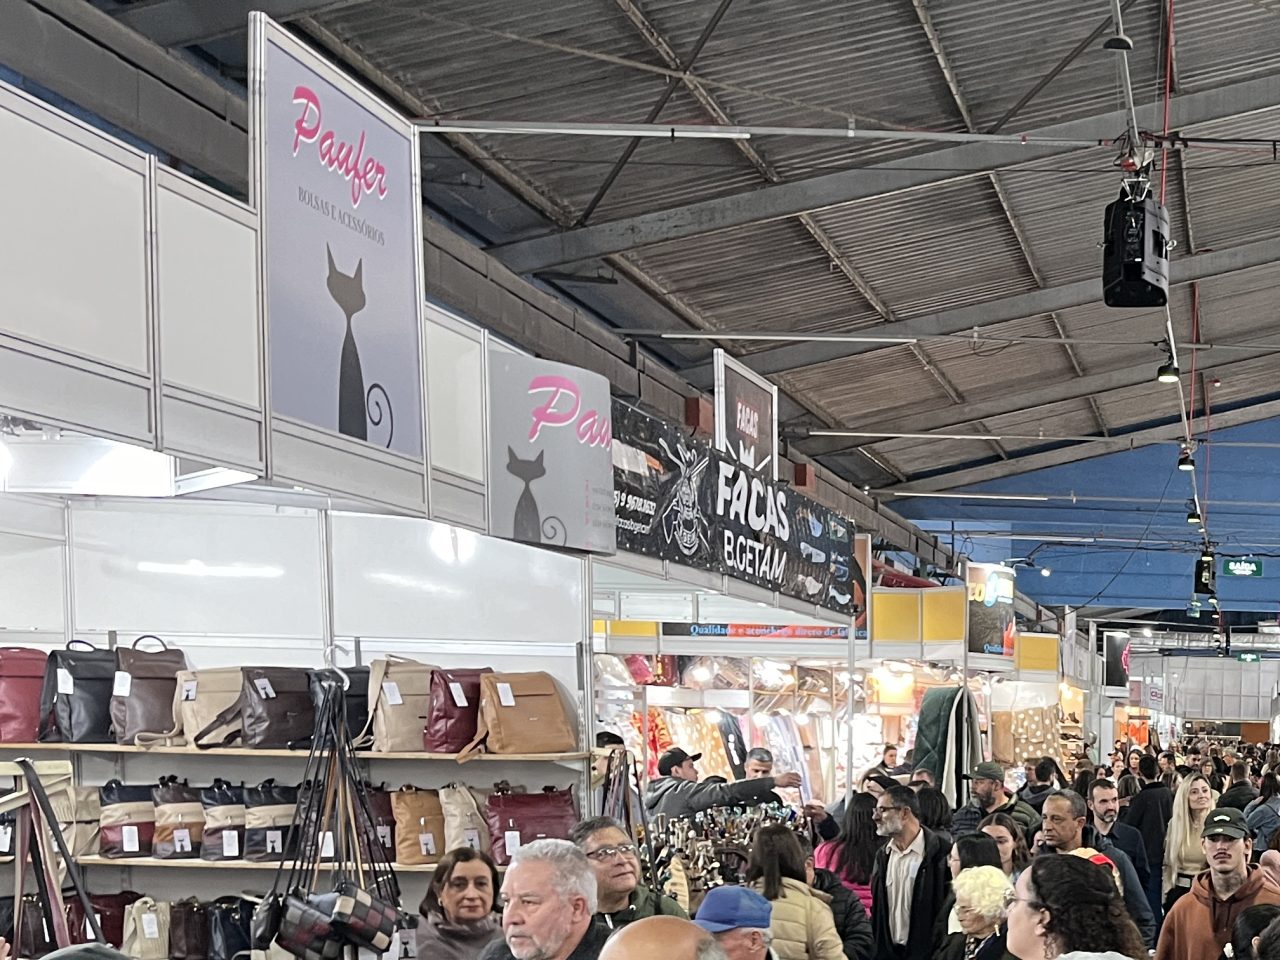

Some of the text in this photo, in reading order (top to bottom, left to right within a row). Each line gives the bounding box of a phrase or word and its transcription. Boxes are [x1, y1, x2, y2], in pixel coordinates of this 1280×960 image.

[292, 85, 388, 209] Paufer
[298, 186, 330, 217] BOLSAS
[337, 211, 385, 246] ACESSÓRIOS
[736, 401, 759, 439] FACAS
[716, 460, 790, 541] FACAS
[1228, 560, 1257, 571] SAÍDA
[690, 624, 737, 637] Qualidade
